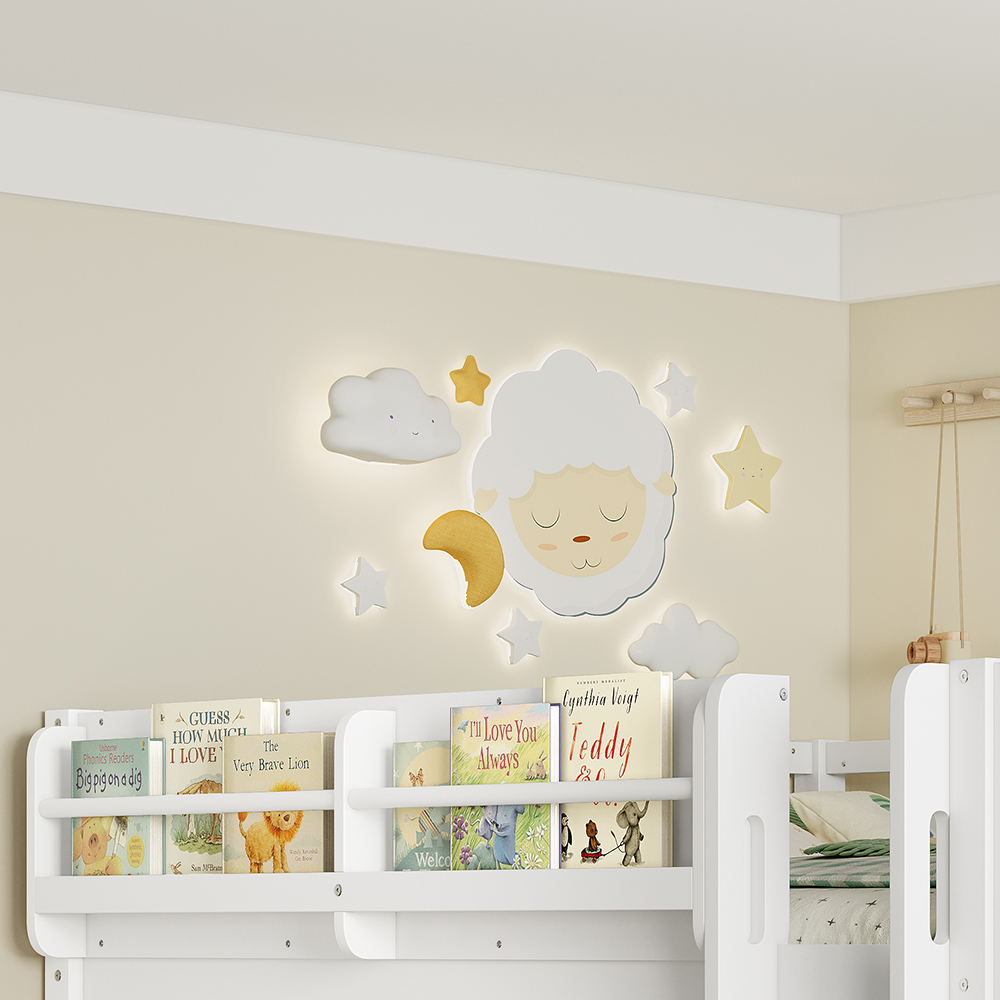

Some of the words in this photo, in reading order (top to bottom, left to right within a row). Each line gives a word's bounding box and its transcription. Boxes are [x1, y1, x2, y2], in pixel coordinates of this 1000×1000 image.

[563, 688, 606, 716] Cynthia
[612, 686, 639, 714] Voigt
[189, 710, 230, 726] GUESS
[173, 729, 203, 744] HOW
[470, 721, 481, 738] I'll
[484, 716, 513, 741] Love
[514, 719, 537, 743] You
[98, 744, 118, 752] Usborne
[263, 739, 279, 752] The
[569, 720, 633, 778] Teddy
[82, 753, 107, 765] Phonics
[108, 752, 135, 764] Readers
[170, 748, 175, 764] I
[180, 746, 217, 764] LOVE
[477, 746, 519, 776] Always
[233, 759, 255, 776] Very
[259, 758, 285, 771] Brave
[288, 757, 310, 770] Lion
[128, 767, 142, 791] dig
